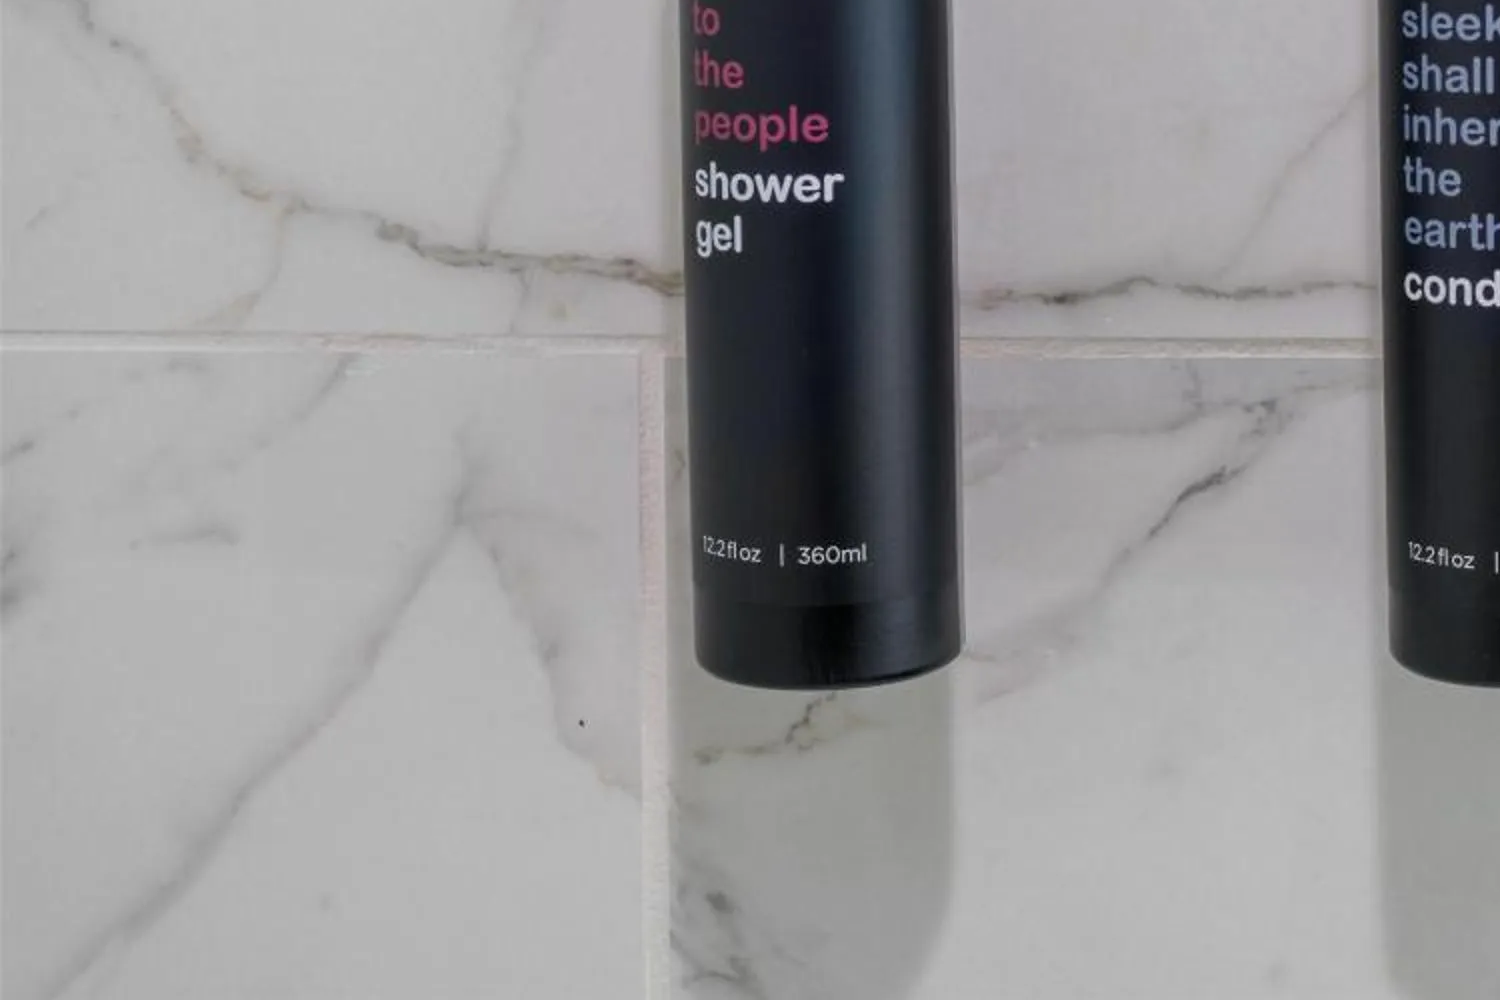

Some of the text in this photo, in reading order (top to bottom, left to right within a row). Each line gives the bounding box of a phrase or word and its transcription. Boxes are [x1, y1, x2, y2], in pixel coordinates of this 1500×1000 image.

[692, 0, 720, 36] to
[693, 50, 744, 89] the
[1402, 54, 1495, 94] shall
[695, 105, 829, 151] people
[695, 161, 845, 202] shower
[1403, 156, 1462, 197] the
[696, 215, 743, 257] gel
[798, 542, 867, 564] 360ml
